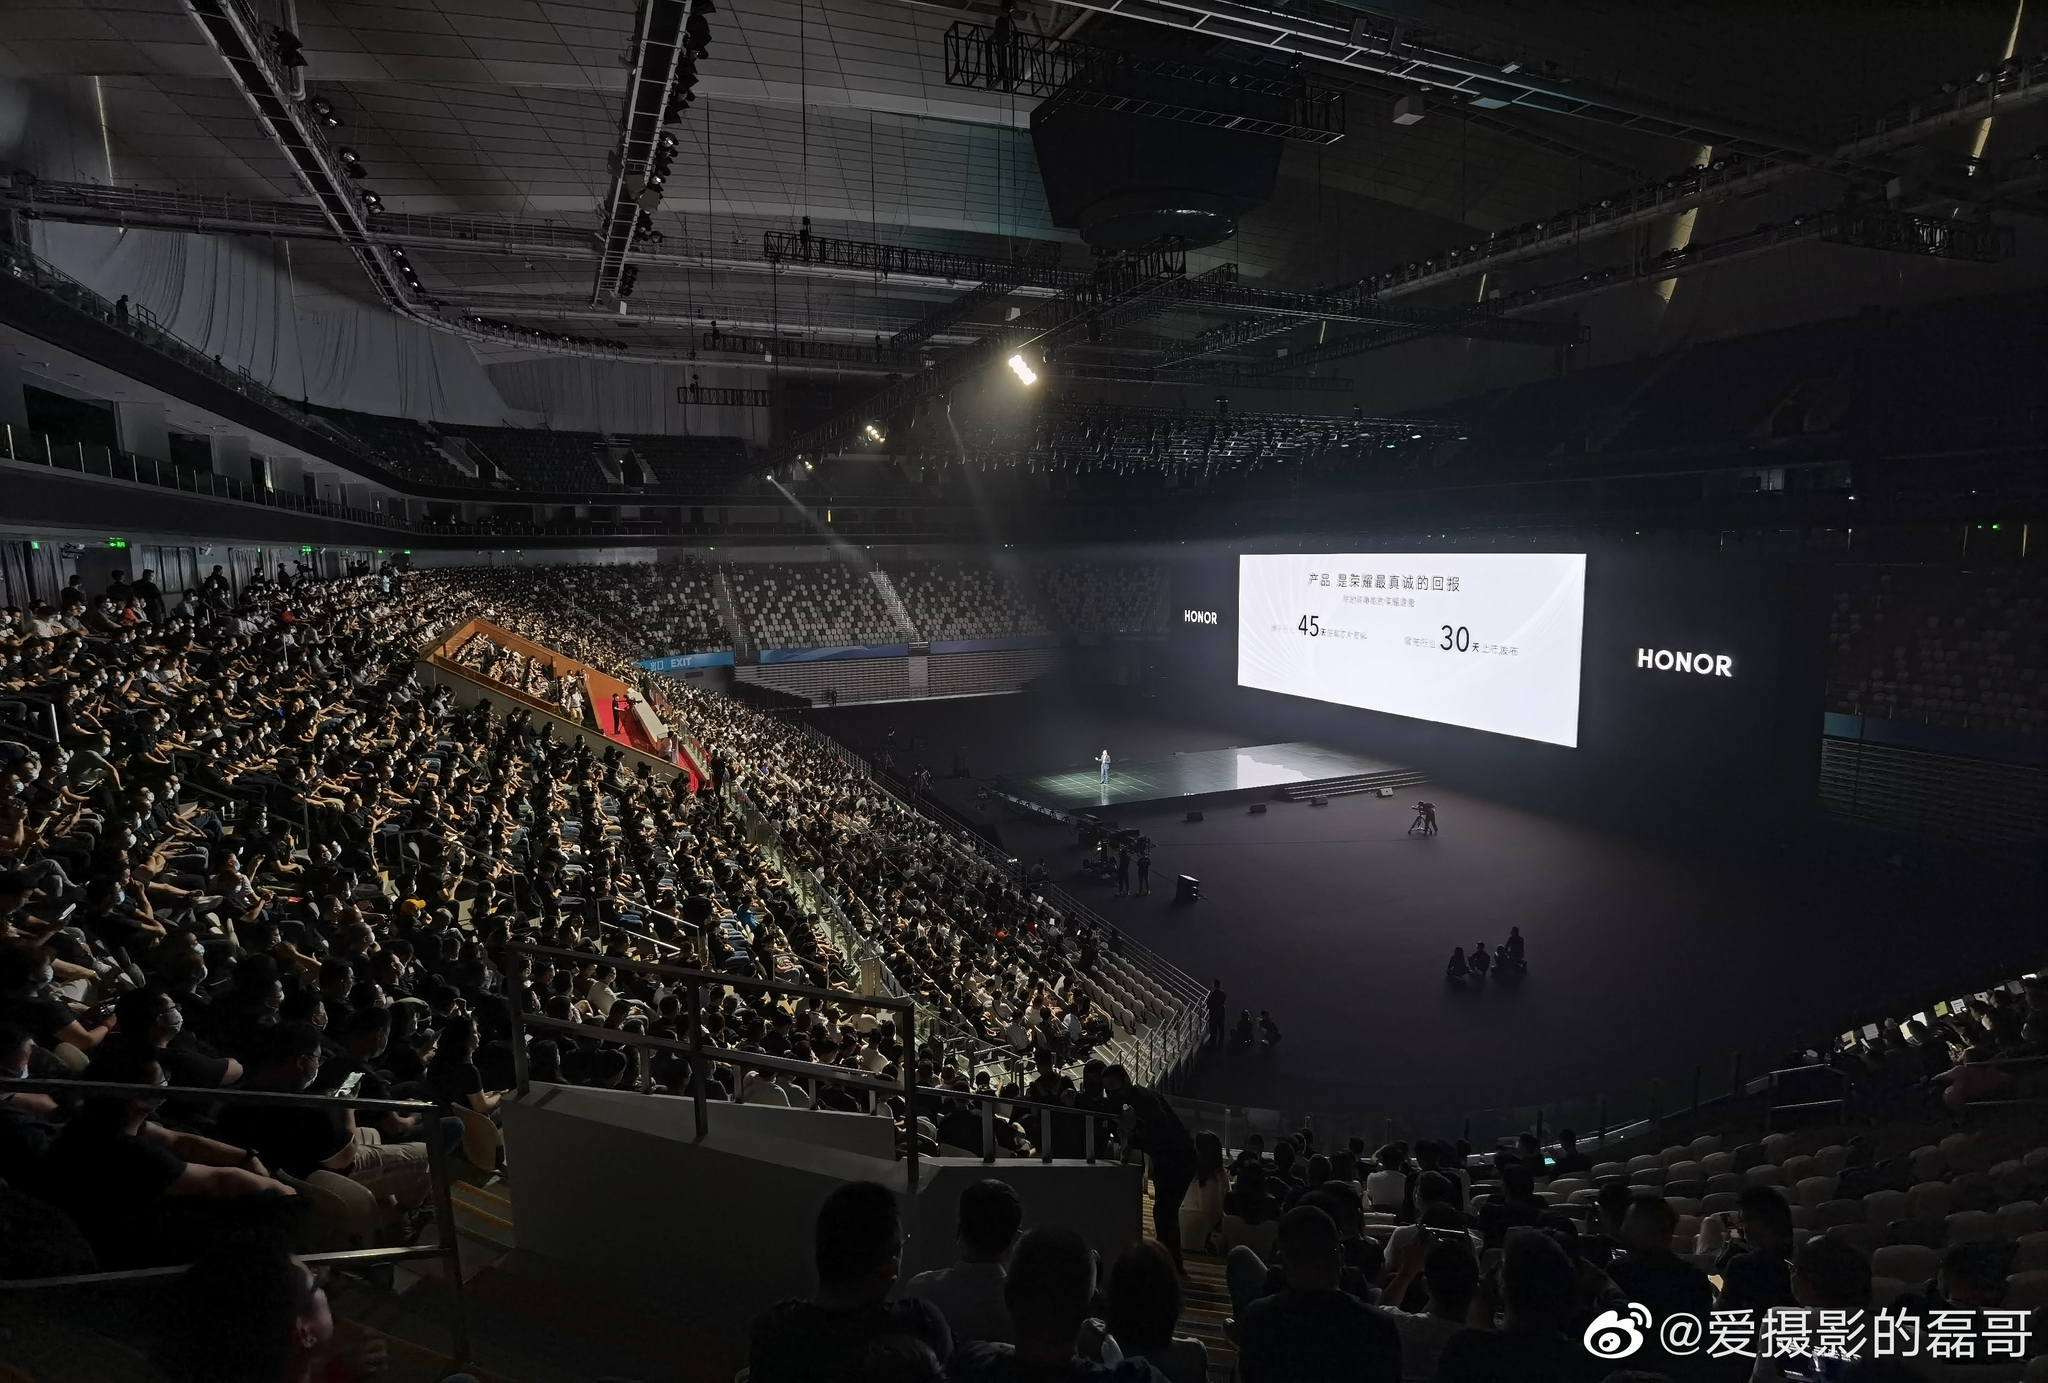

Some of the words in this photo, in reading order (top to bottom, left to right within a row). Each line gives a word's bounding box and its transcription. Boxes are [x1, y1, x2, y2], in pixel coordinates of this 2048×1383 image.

[1308, 572, 1331, 587] 产品
[1336, 573, 1460, 592] 是荣耀最真诚的回报
[1184, 609, 1218, 625] HONOR
[670, 657, 692, 668] EXIT
[1637, 648, 1733, 678] HONOR
